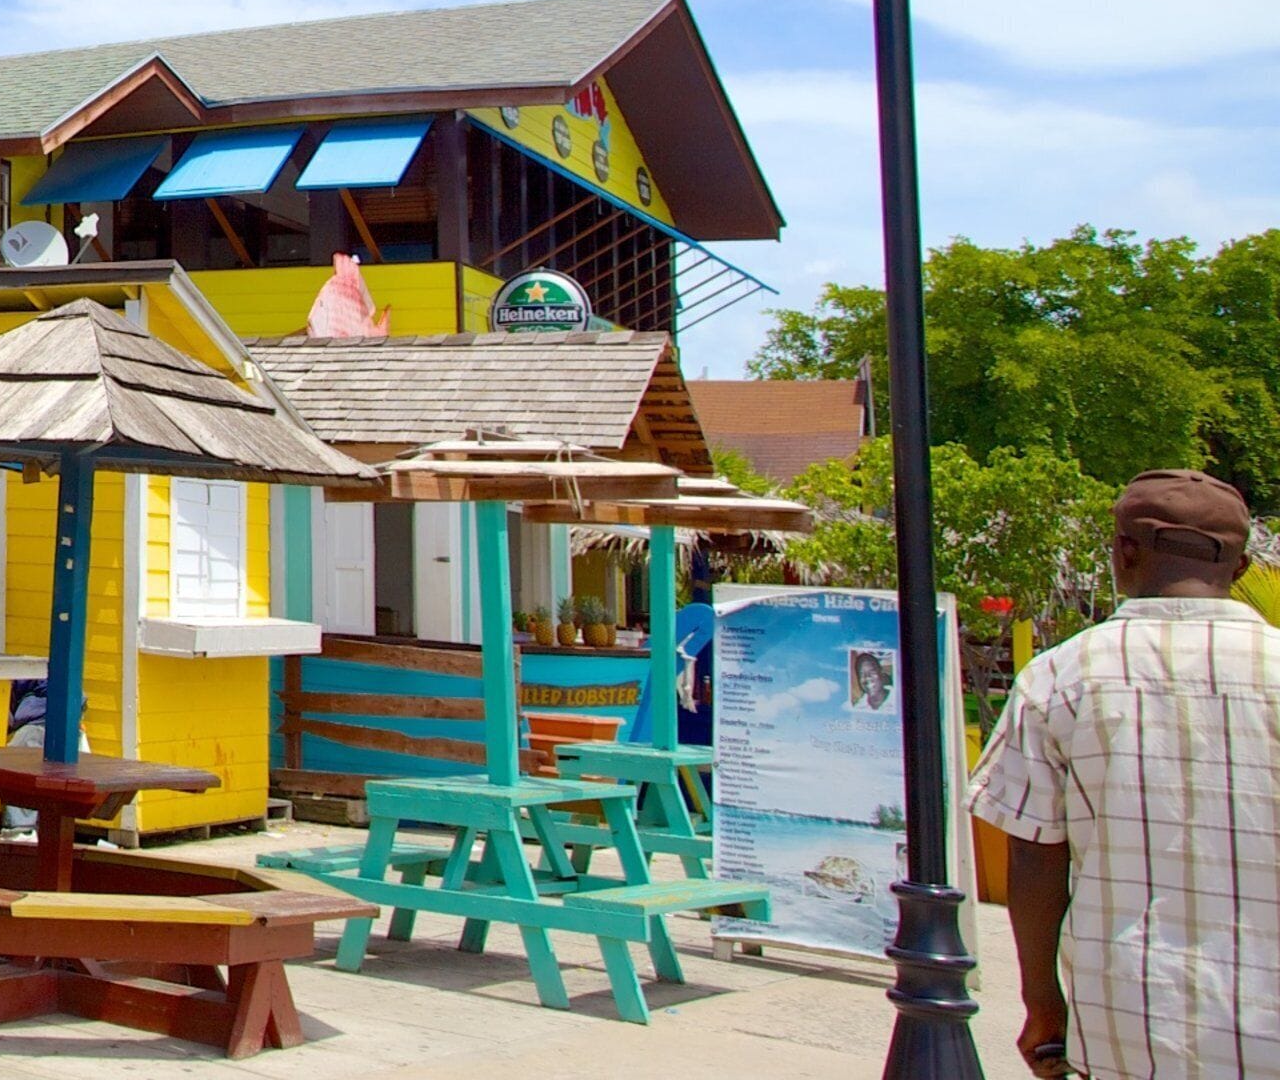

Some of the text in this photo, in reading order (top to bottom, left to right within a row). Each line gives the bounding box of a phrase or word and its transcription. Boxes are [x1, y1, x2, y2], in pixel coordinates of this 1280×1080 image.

[499, 306, 579, 321] Heineken
[824, 594, 865, 612] Hide
[566, 687, 638, 706] LOBSTER
